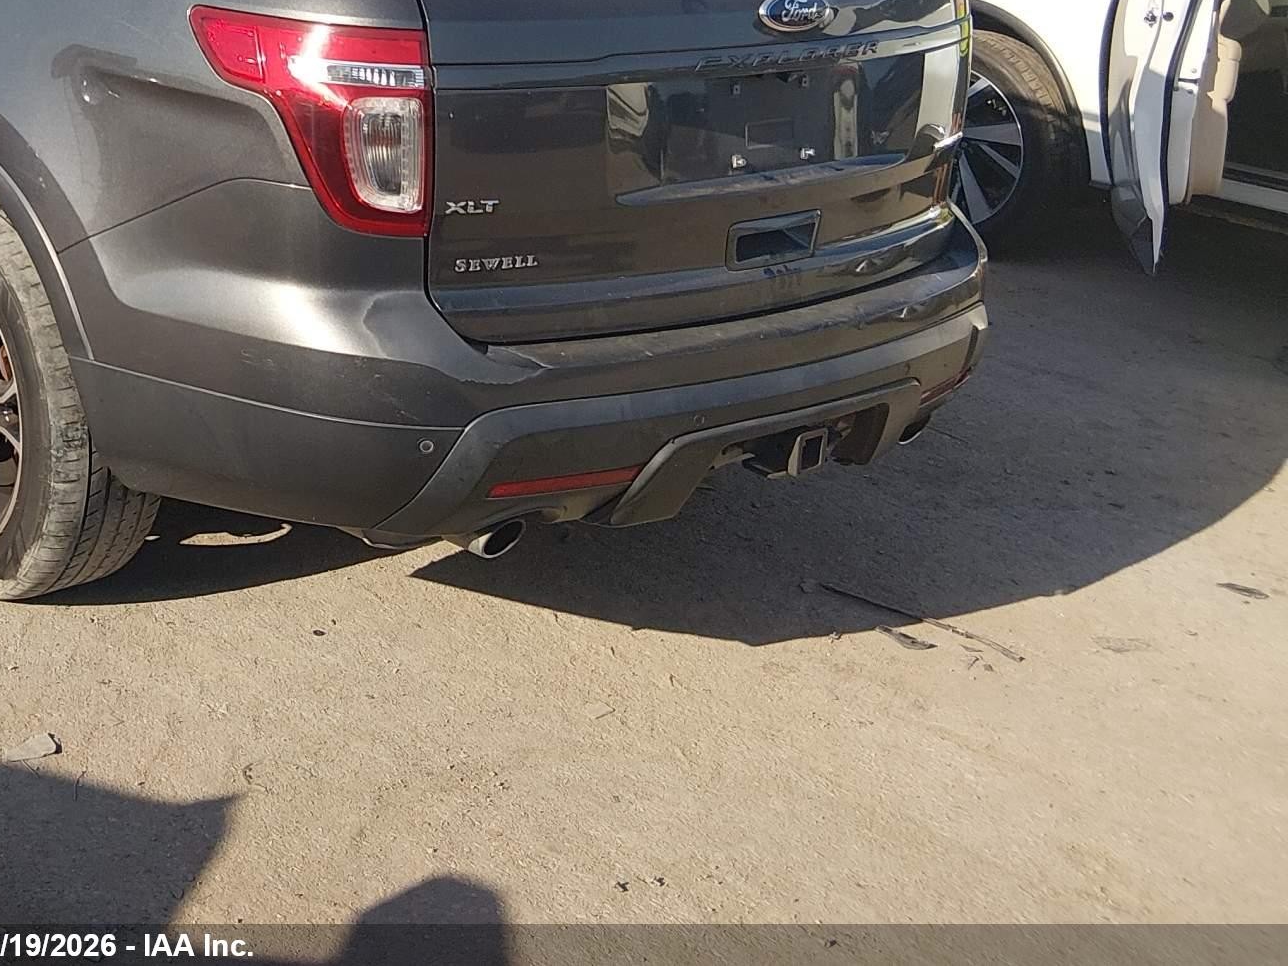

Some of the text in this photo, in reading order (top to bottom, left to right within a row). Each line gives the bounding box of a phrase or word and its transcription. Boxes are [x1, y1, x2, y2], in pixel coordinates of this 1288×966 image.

[695, 39, 880, 72] EXPLORER
[445, 199, 500, 214] XLT
[454, 255, 538, 272] SEWELL
